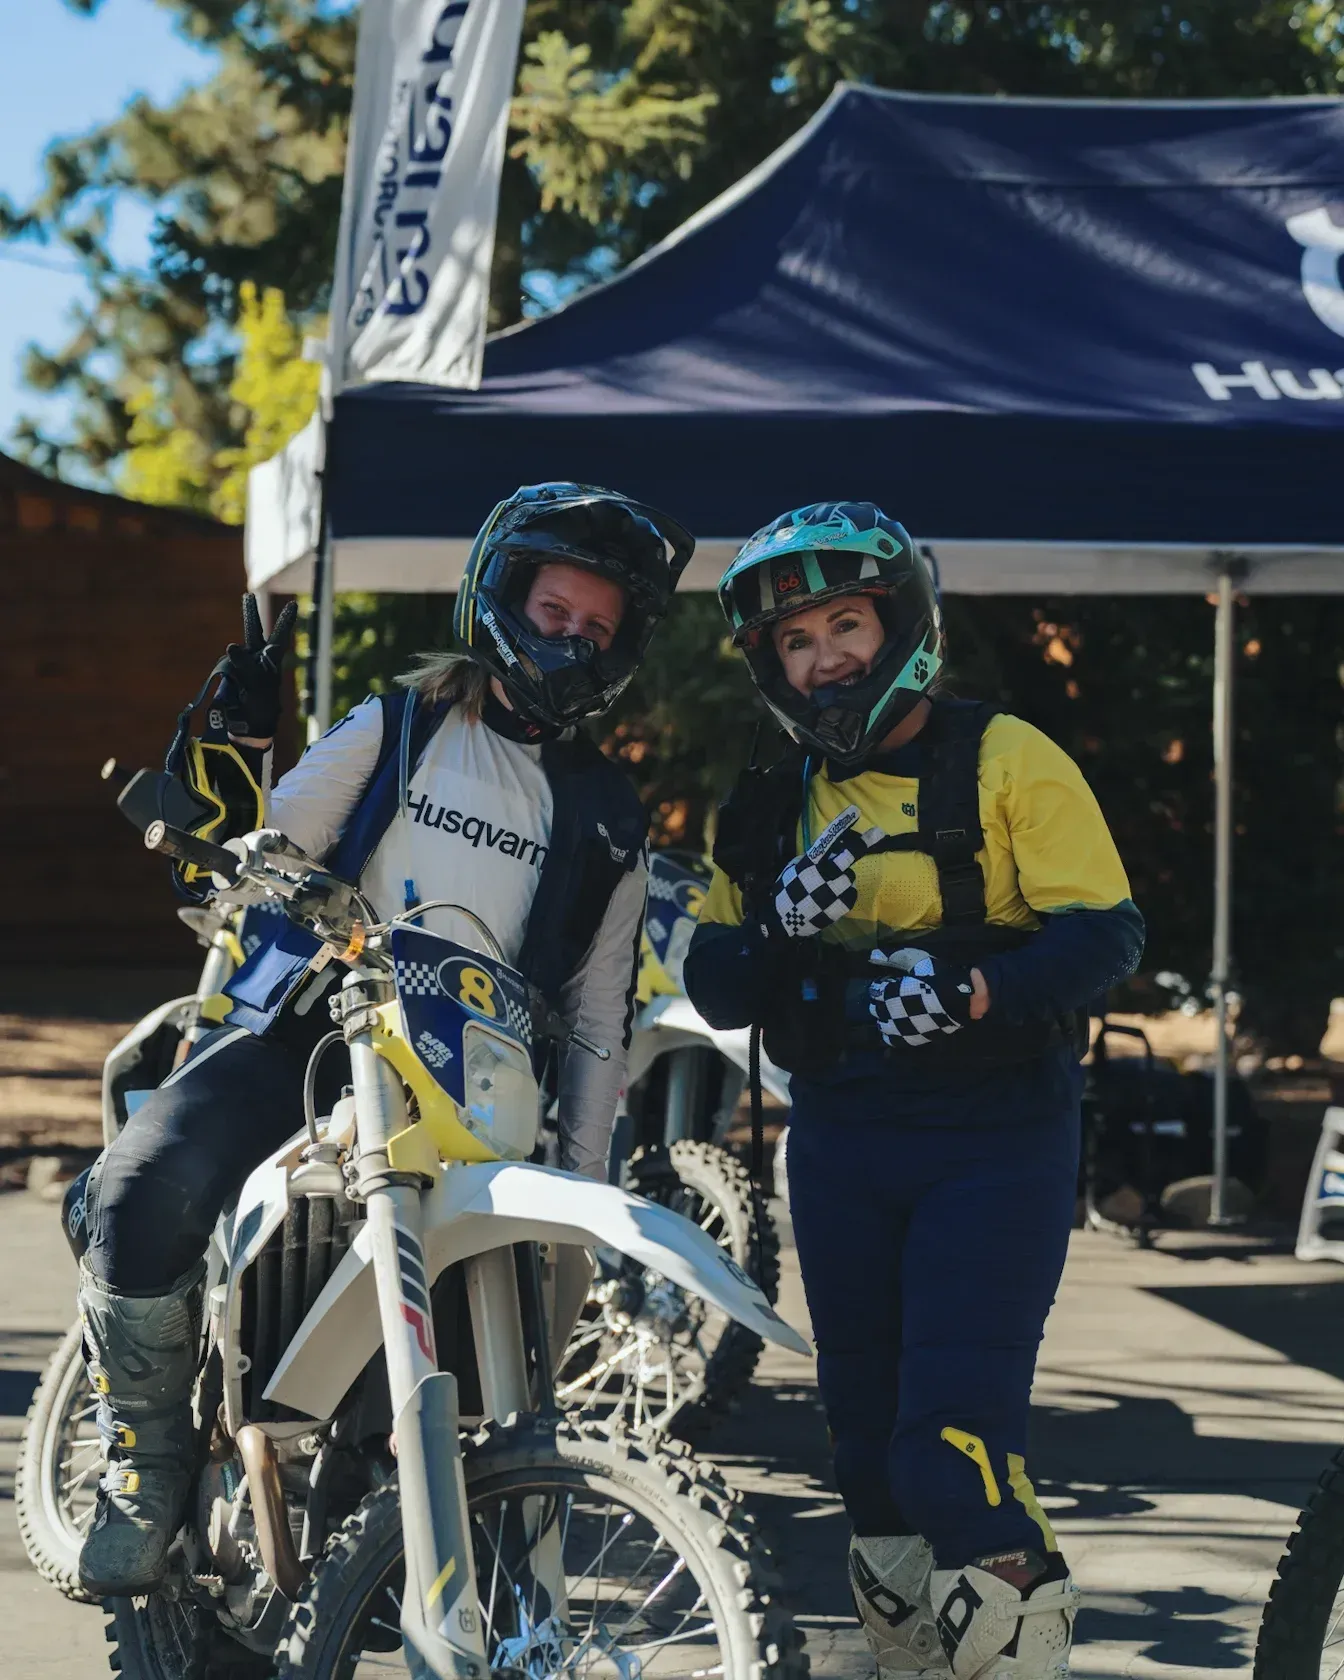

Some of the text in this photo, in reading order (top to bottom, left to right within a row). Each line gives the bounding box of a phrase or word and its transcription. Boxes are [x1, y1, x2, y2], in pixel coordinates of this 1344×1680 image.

[1191, 360, 1344, 400] Hu
[459, 967, 497, 1018] 8
[415, 1041, 444, 1068] DIRT
[419, 1030, 454, 1061] BABES
